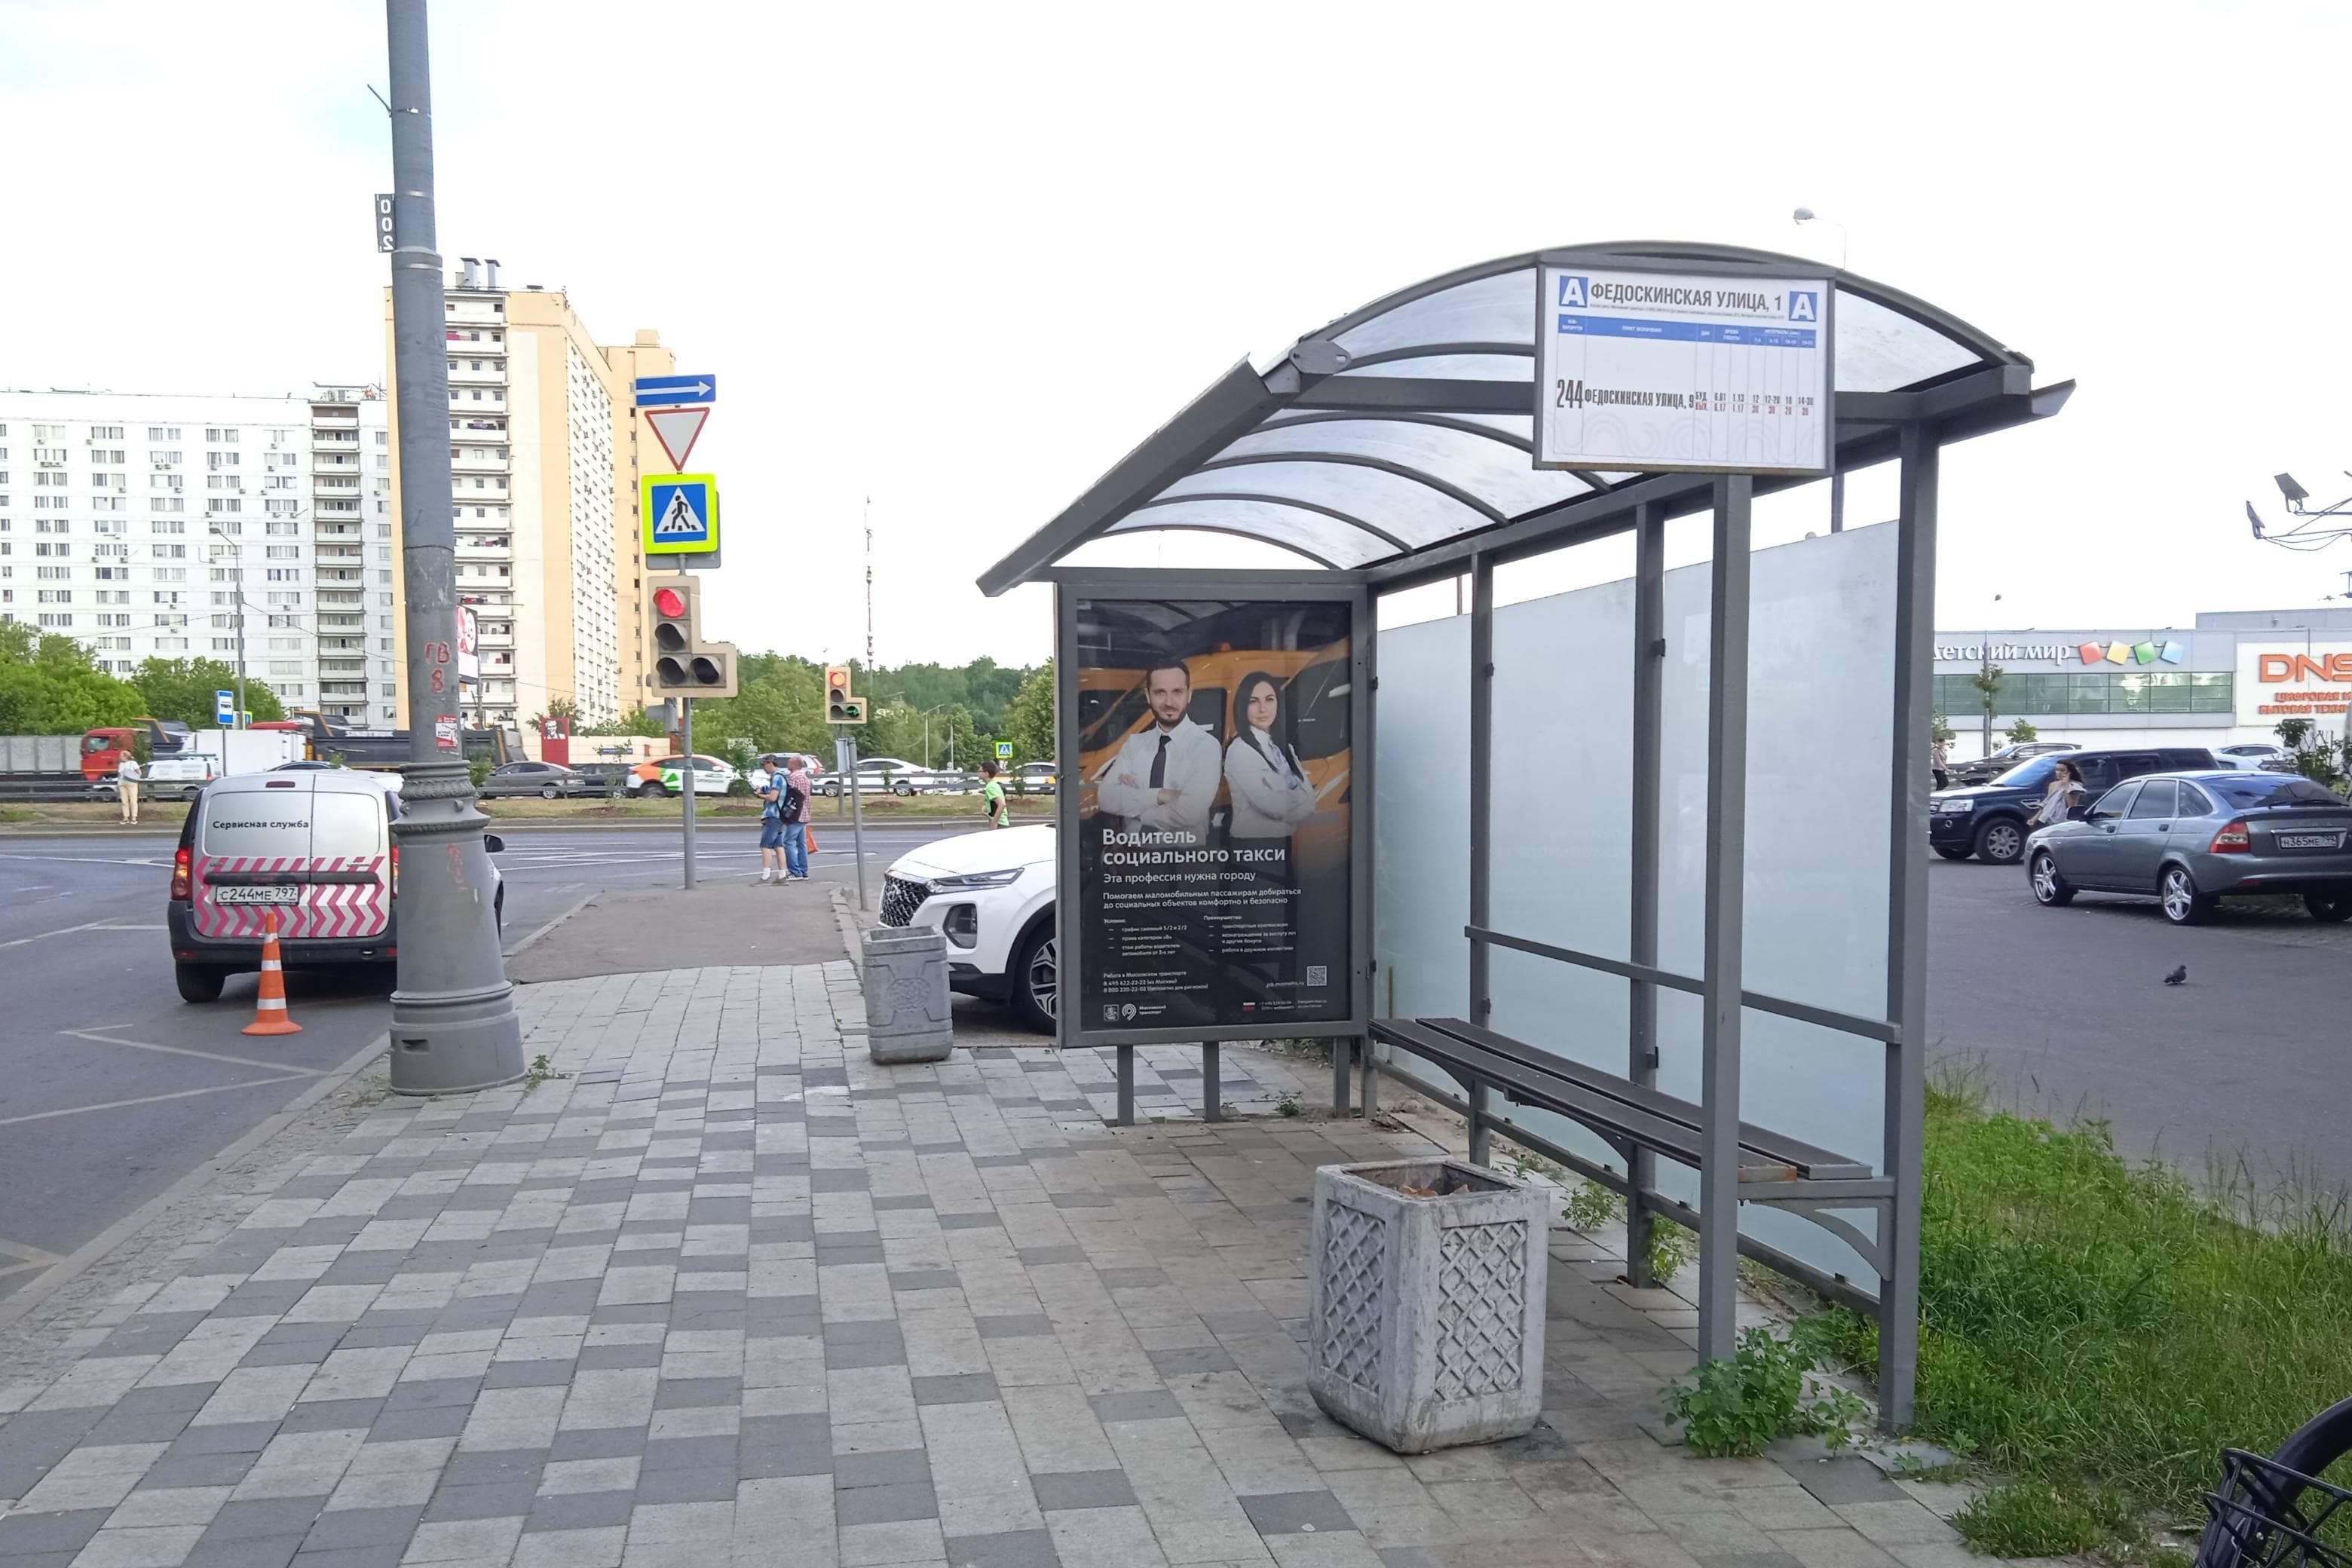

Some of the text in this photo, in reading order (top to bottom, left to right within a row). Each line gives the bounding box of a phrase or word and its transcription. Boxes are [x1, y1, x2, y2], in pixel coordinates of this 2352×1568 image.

[1561, 277, 1586, 306] А
[1591, 283, 1712, 308] ФЕДОСКИНСКАЯ
[1717, 291, 1770, 312] УЛИЦА,
[1775, 295, 1782, 311] 1
[1790, 293, 1815, 320] А
[1556, 378, 1695, 409] 244 ФЕДОСКИНСКАЯ УЛИЦА, 9
[2024, 644, 2070, 666] мир
[213, 819, 310, 830] Сервисная служба
[1103, 828, 1197, 847] Водитель
[1103, 849, 1285, 867] социального такси
[1103, 871, 1256, 885] Эта профессия нужна городу
[221, 887, 296, 901] С244МЕ 797
[1103, 887, 1301, 900] Помогаем маломобильным пассажирам добираться
[1115, 901, 1161, 909] социальных
[1162, 899, 1197, 907] объектов
[1199, 898, 1242, 906] комфортно
[1249, 896, 1288, 905] безопасно
